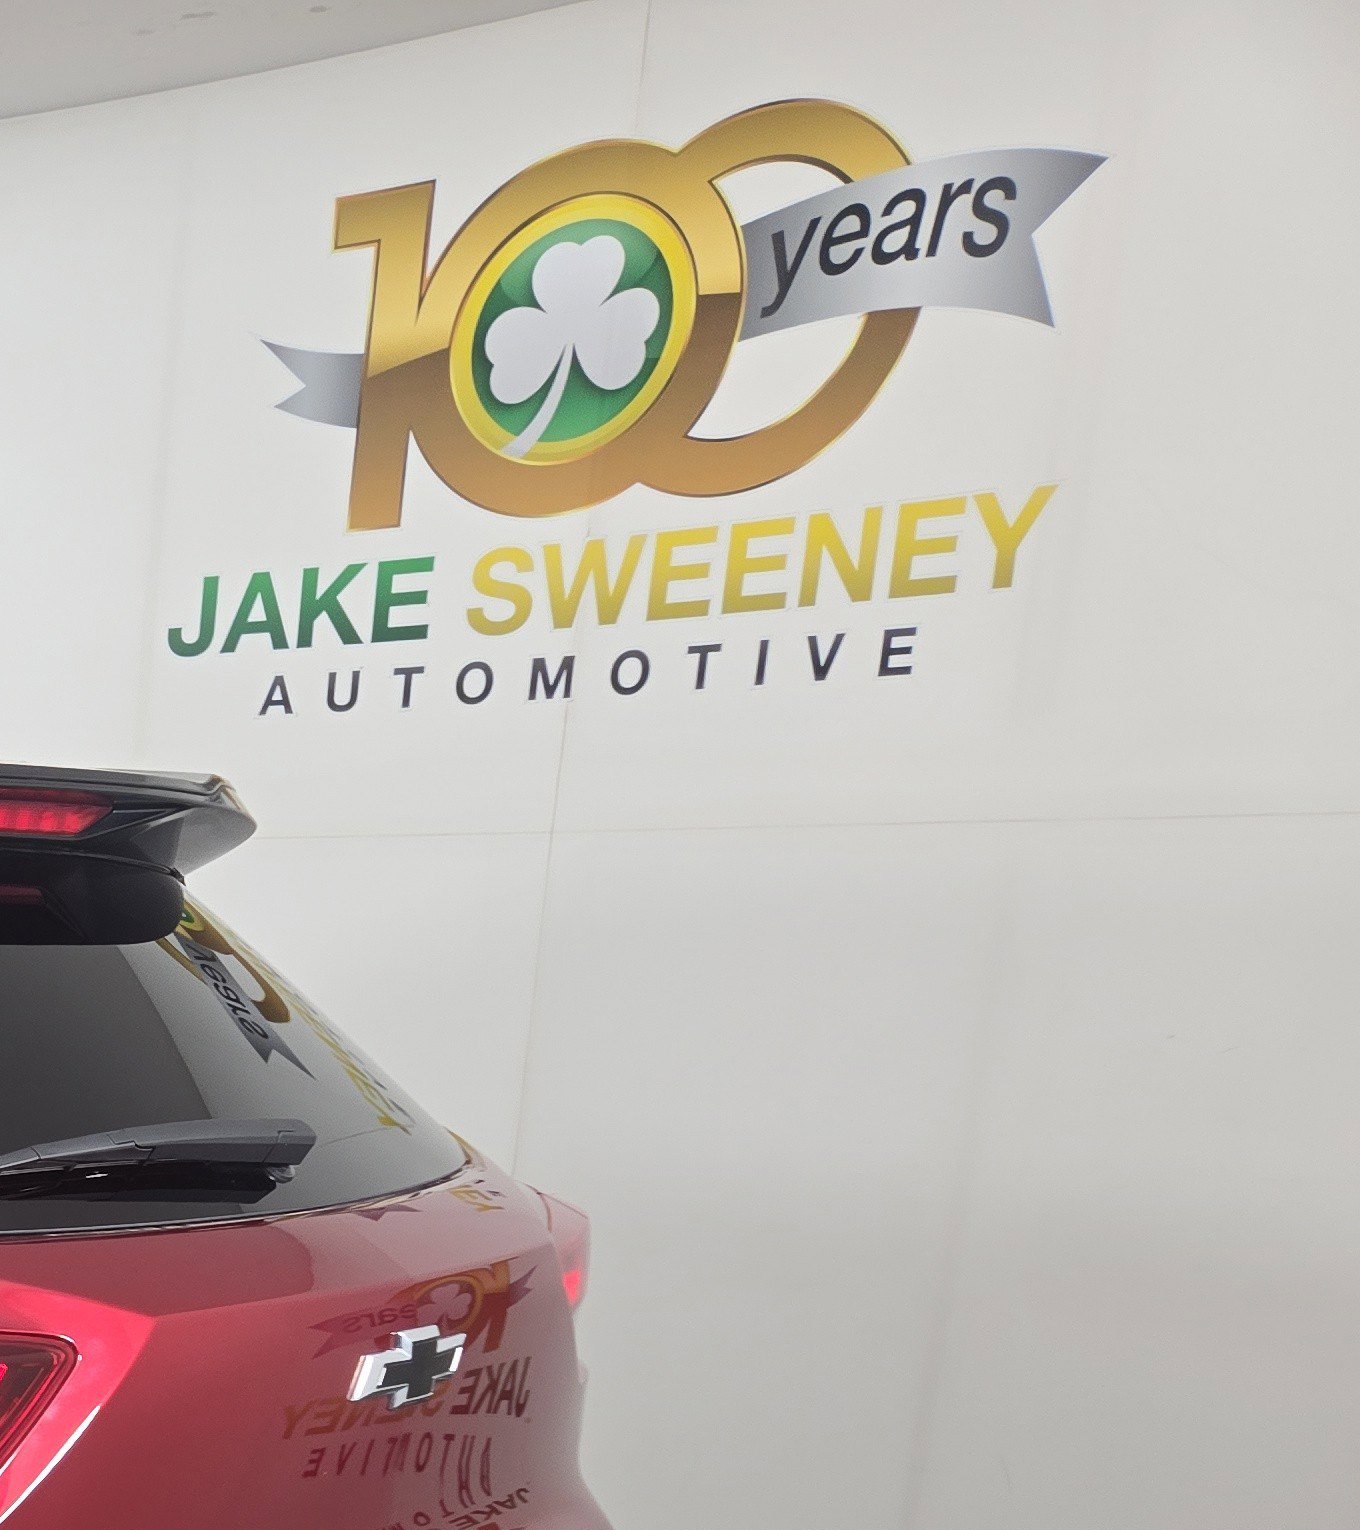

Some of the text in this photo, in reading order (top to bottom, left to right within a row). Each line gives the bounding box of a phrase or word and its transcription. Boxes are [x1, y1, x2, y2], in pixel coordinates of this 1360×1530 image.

[760, 175, 1017, 320] years
[167, 483, 1060, 658] JAKE SWEENEY
[258, 627, 918, 715] AUTOMOTIVE
